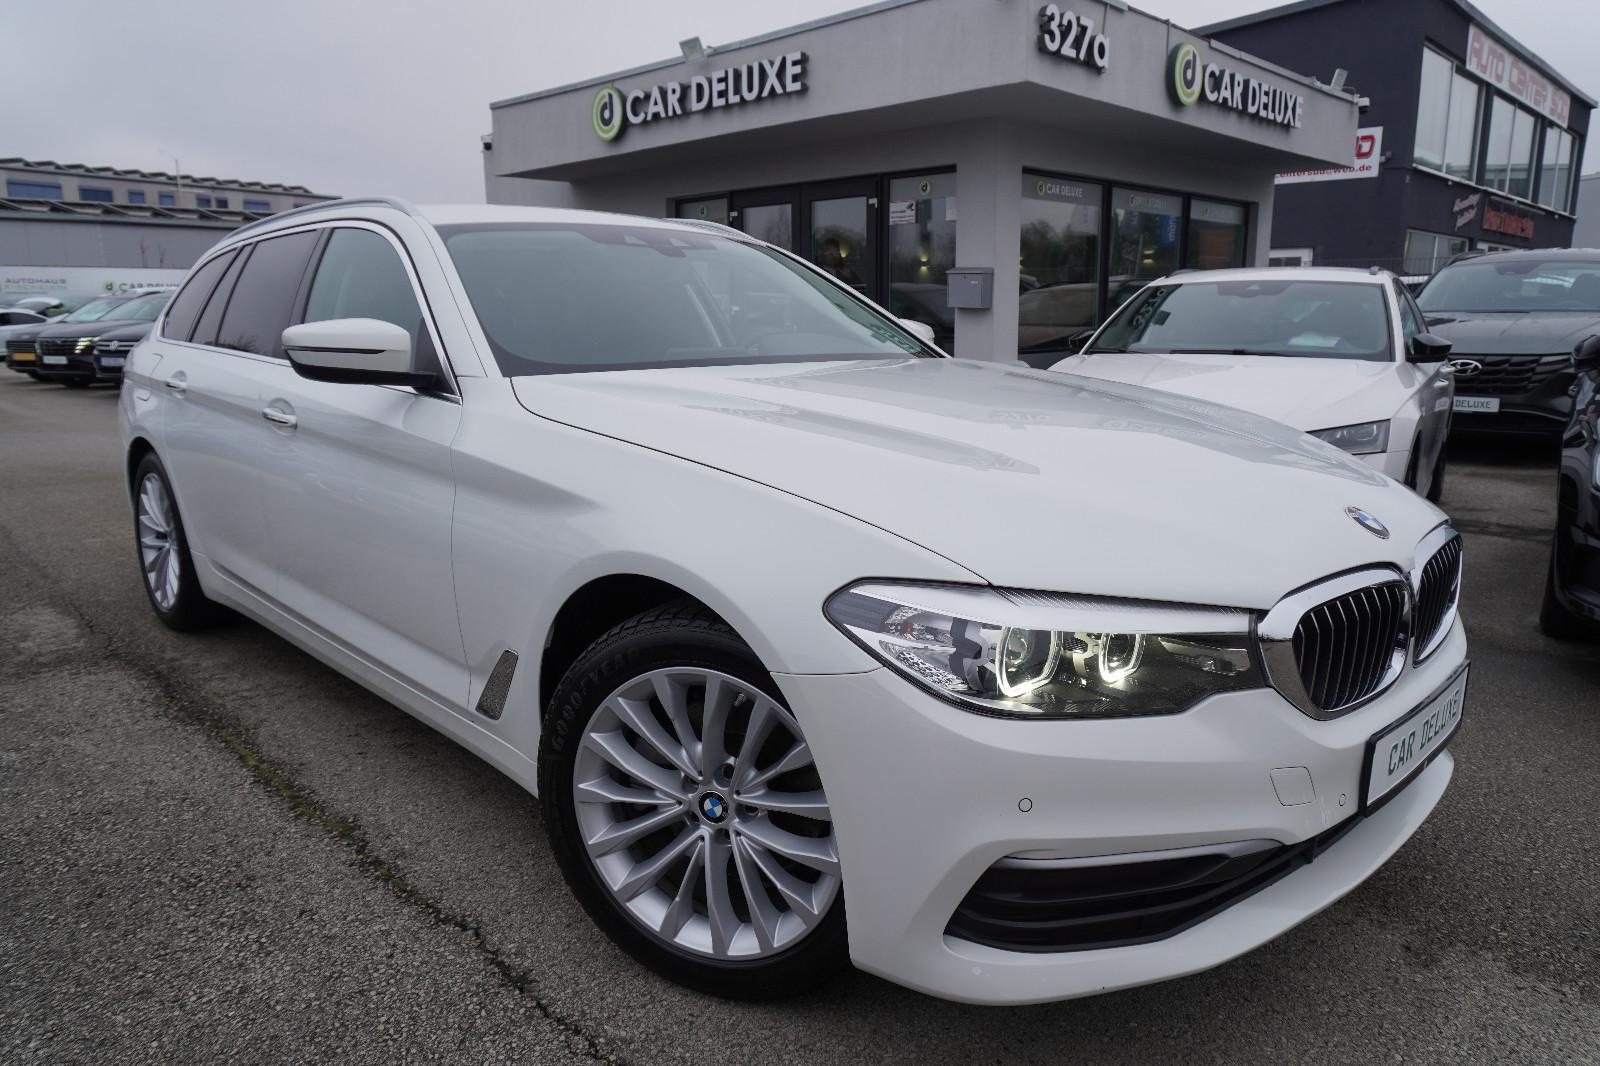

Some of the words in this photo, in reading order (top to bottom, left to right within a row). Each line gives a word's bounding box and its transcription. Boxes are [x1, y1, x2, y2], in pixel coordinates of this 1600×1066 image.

[1043, 4, 1110, 70] 327a
[626, 81, 683, 125] CAR
[691, 52, 802, 112] DELUXE
[1204, 63, 1243, 110] CAR
[1247, 78, 1304, 128] DELUXE
[1046, 183, 1061, 196] CAR
[1061, 185, 1083, 198] DELUXE
[5, 277, 67, 285] AUTOHAUS
[1455, 399, 1492, 409] DELUXE
[1387, 729, 1416, 776] CAR
[1420, 688, 1460, 750] DELUXE
